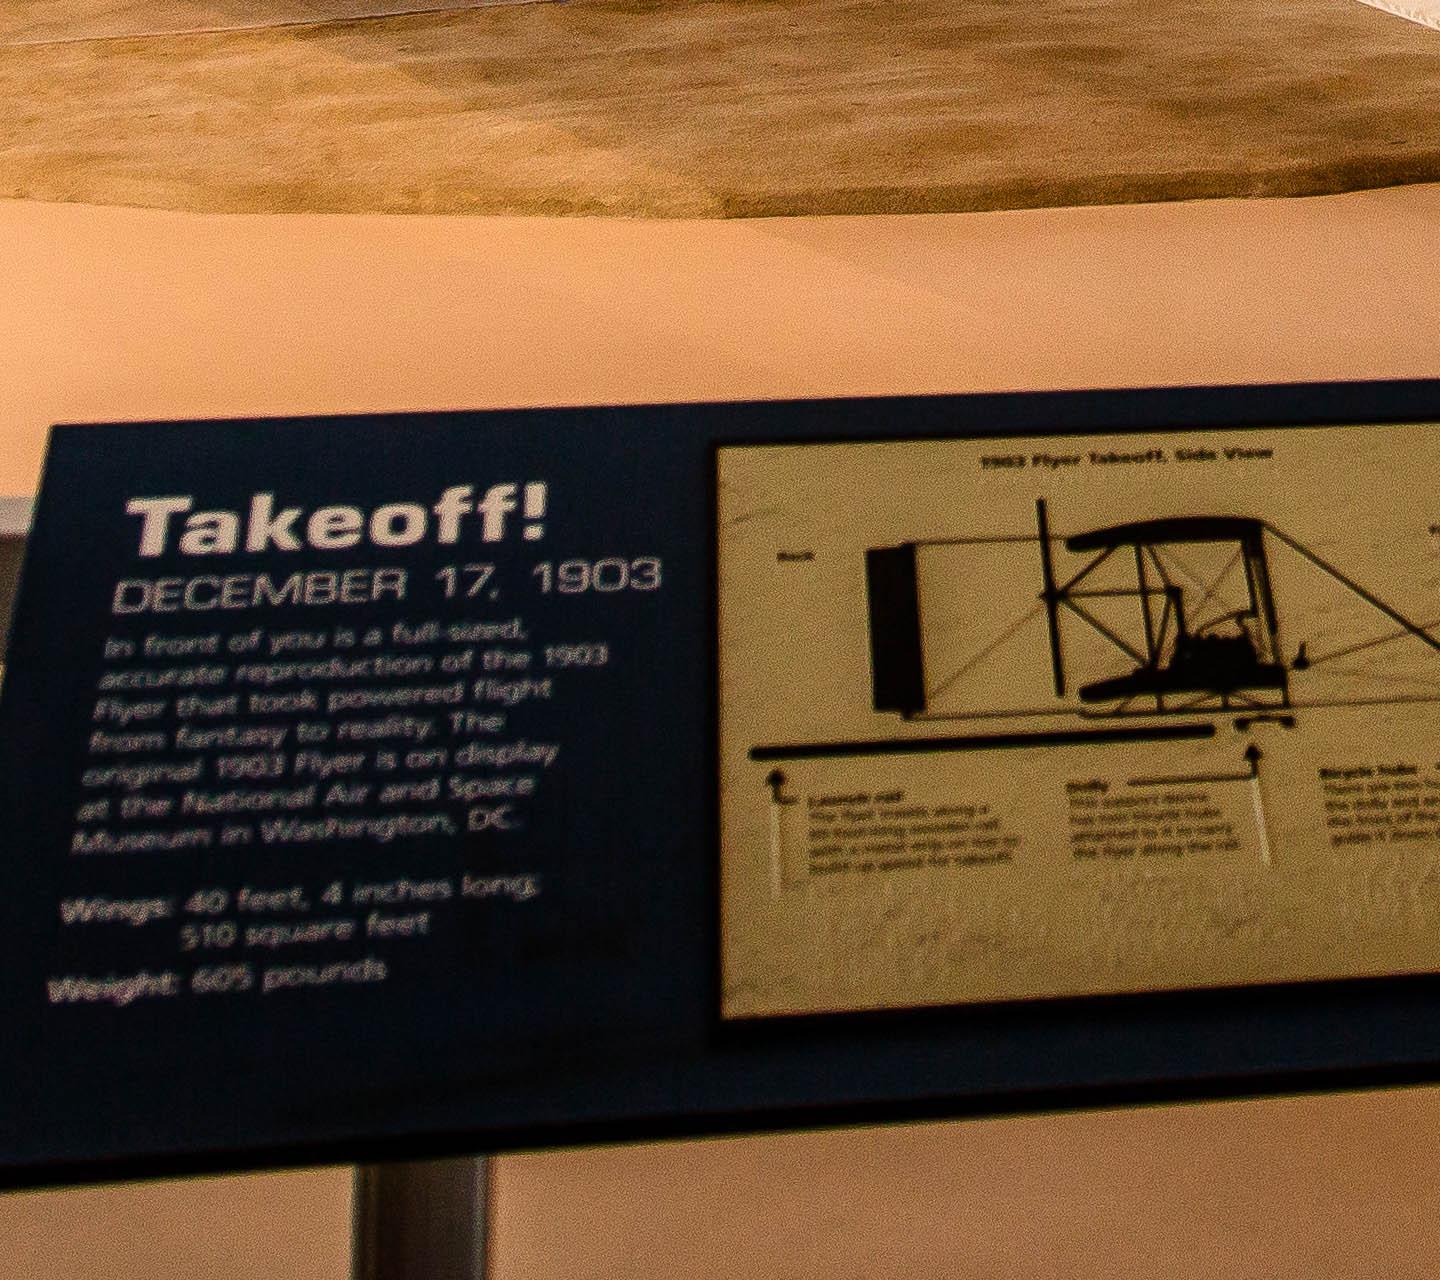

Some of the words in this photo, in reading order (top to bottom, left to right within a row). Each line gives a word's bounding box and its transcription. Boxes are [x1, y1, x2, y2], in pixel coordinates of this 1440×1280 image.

[123, 481, 548, 558] Takeoff!
[111, 568, 407, 615] DECEMBER
[435, 561, 501, 602] 17,
